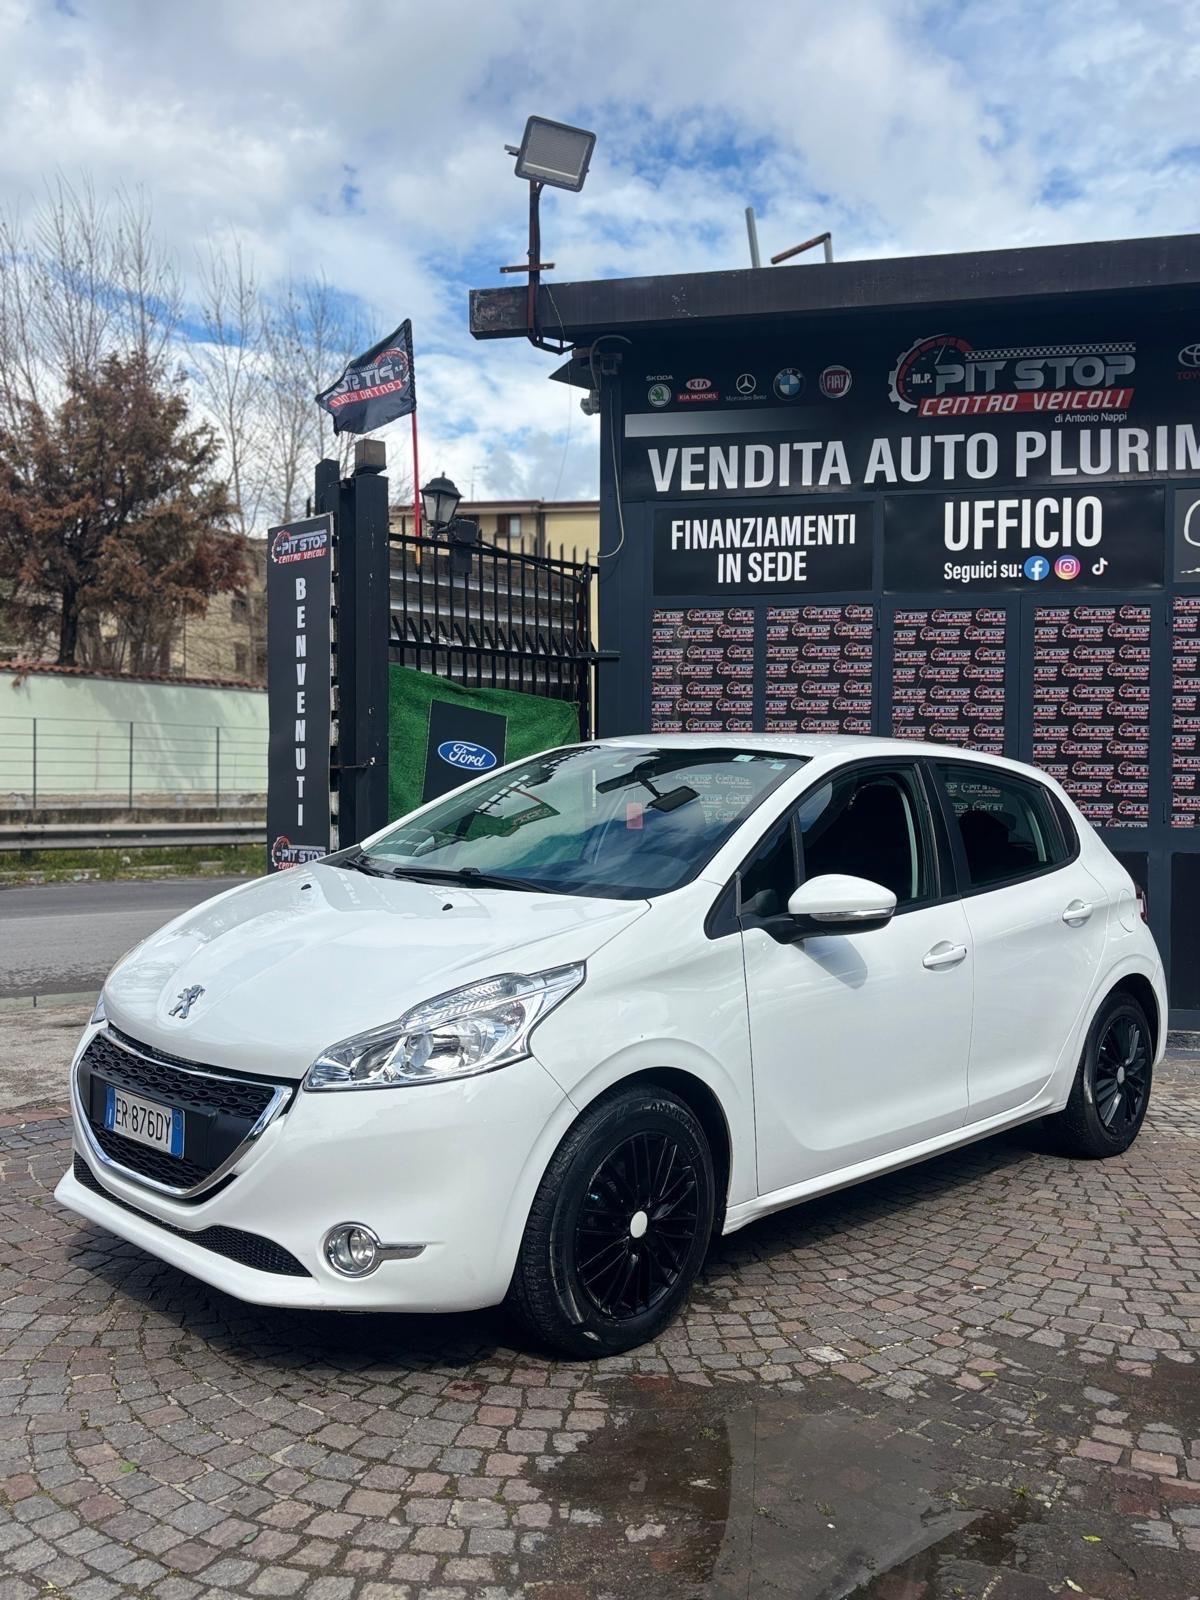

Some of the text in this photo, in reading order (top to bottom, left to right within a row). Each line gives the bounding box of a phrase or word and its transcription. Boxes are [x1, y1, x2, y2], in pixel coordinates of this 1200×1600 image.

[690, 380, 708, 389] KIA
[827, 374, 846, 390] FIAT
[912, 373, 932, 384] M.P.
[934, 355, 1136, 395] PIT STOP
[1176, 371, 1200, 380] TOY
[1054, 412, 1127, 423] di Antonio Nappi
[648, 440, 851, 492] VENDITA
[864, 432, 998, 484] AUTO
[671, 514, 856, 550] FINANZIAMENTI
[944, 496, 1102, 551] UFFICIO
[282, 534, 327, 555] PIT STOP
[718, 551, 807, 584] IN SEDE
[944, 560, 1022, 583] Seguici su:
[294, 577, 307, 826] BENVENUTI
[449, 743, 486, 767] Ford
[281, 849, 298, 862] PIT
[116, 1097, 171, 1144] ER 876DY
